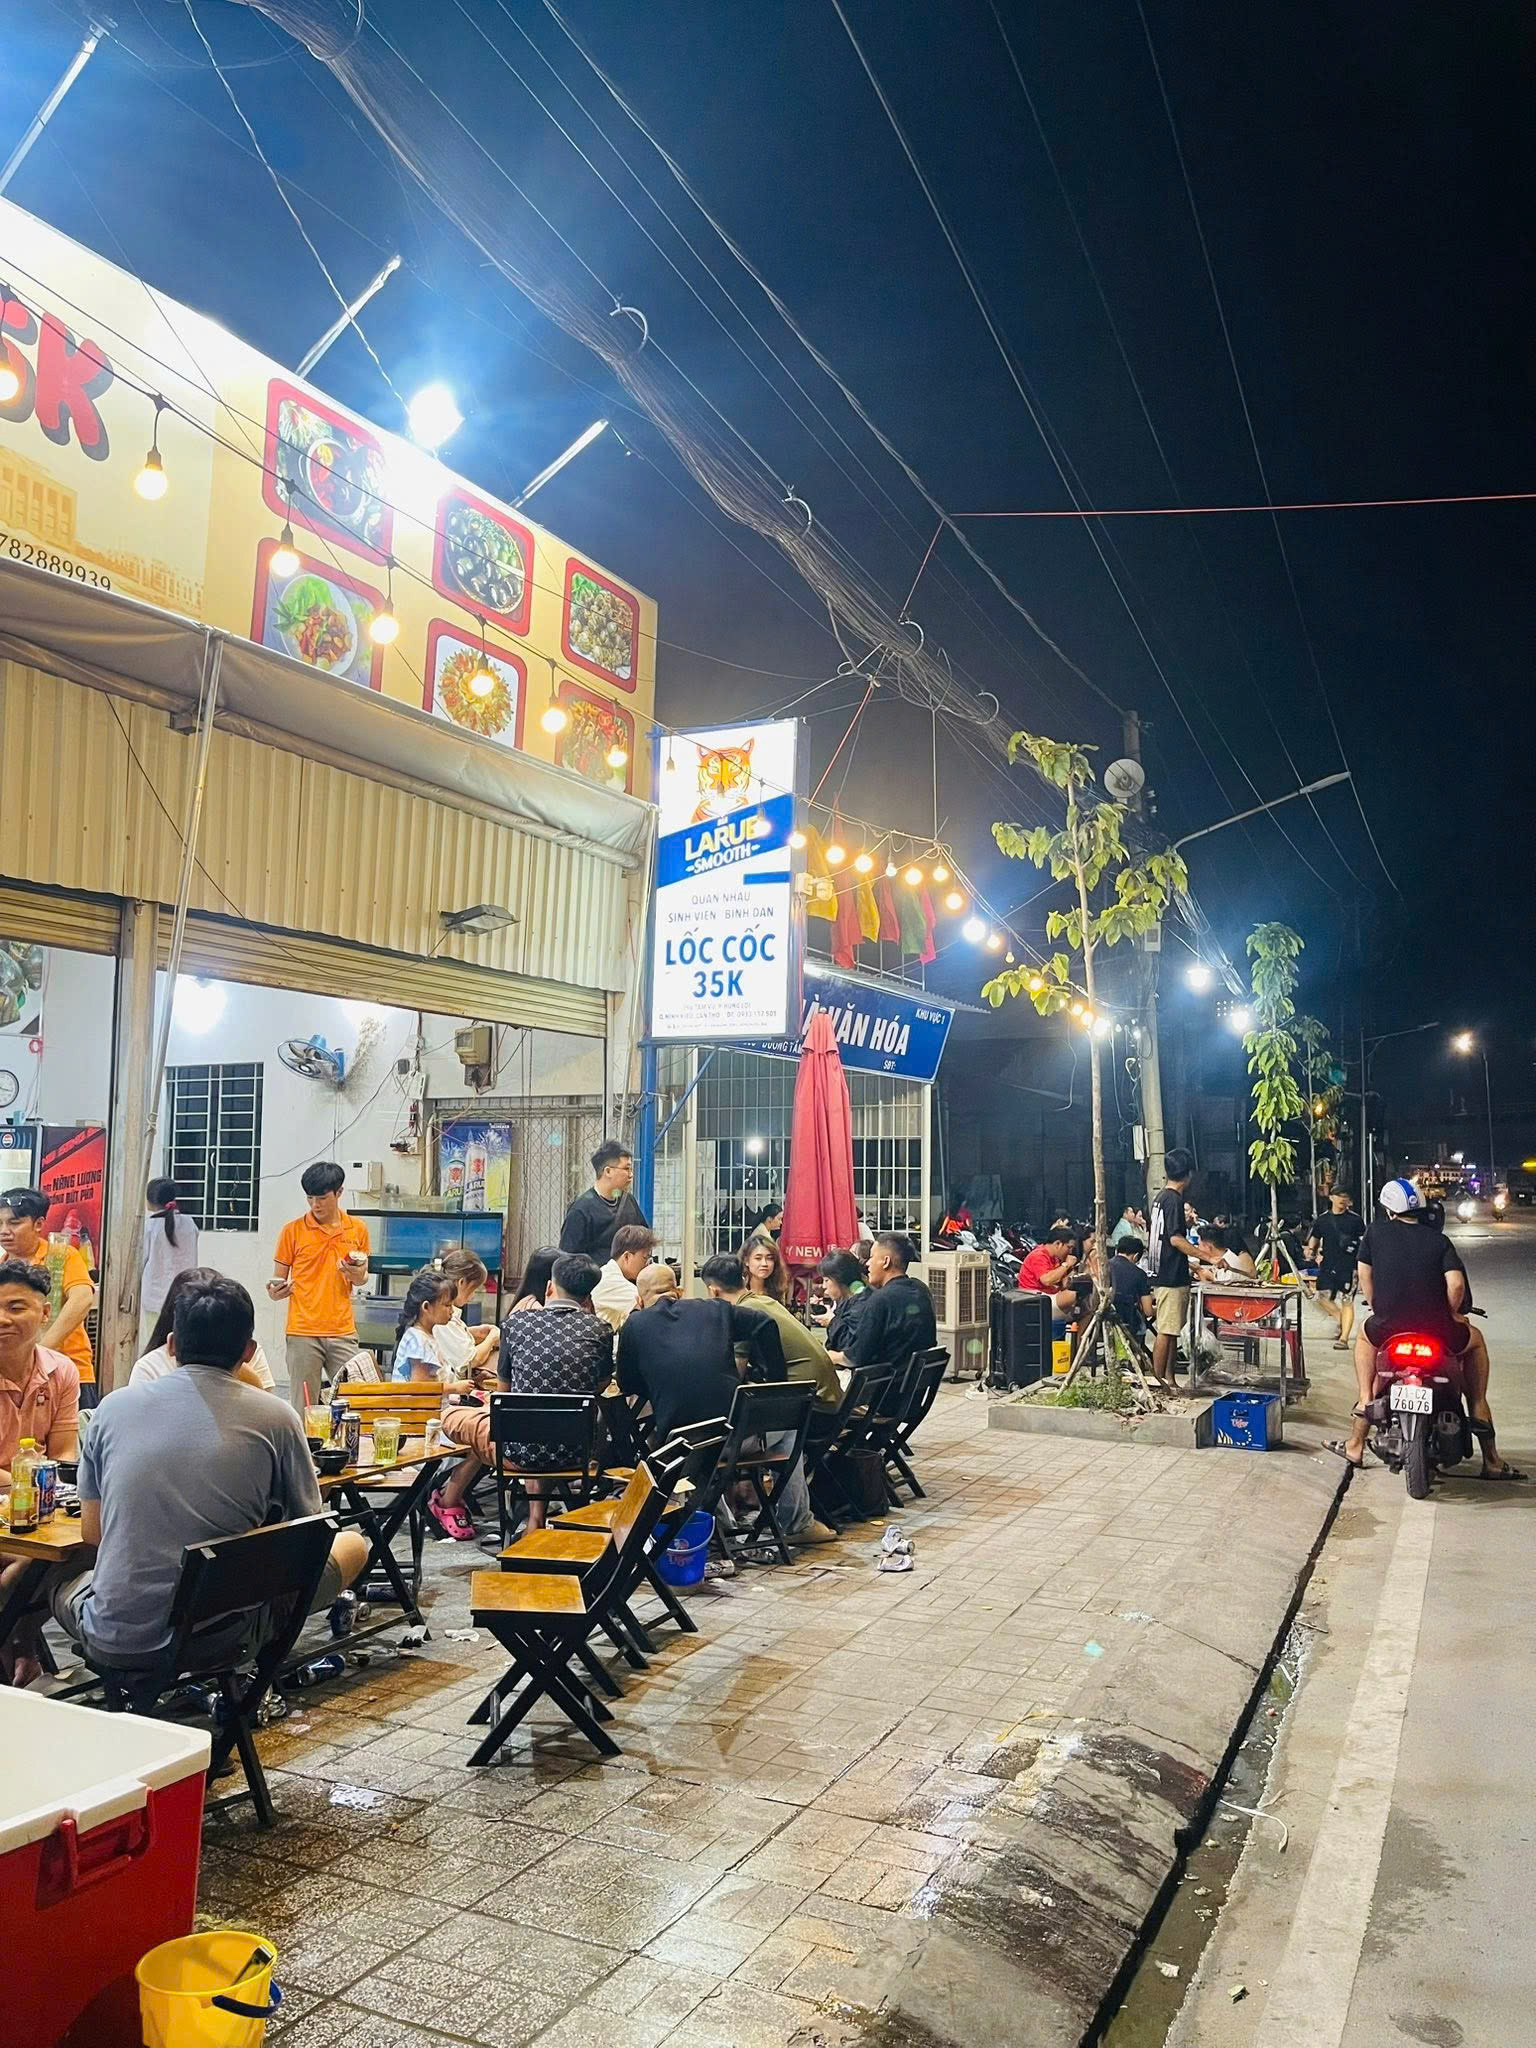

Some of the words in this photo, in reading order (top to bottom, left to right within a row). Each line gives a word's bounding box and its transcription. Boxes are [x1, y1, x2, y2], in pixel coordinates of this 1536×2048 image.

[668, 913, 691, 923] SINH
[665, 927, 714, 965] LỐC
[722, 923, 776, 963] CỐC
[692, 969, 744, 998] 35K
[829, 1002, 870, 1047] VĂN
[869, 1015, 911, 1056] HÓA
[915, 1008, 929, 1021] KHU
[941, 1014, 946, 1024] 1
